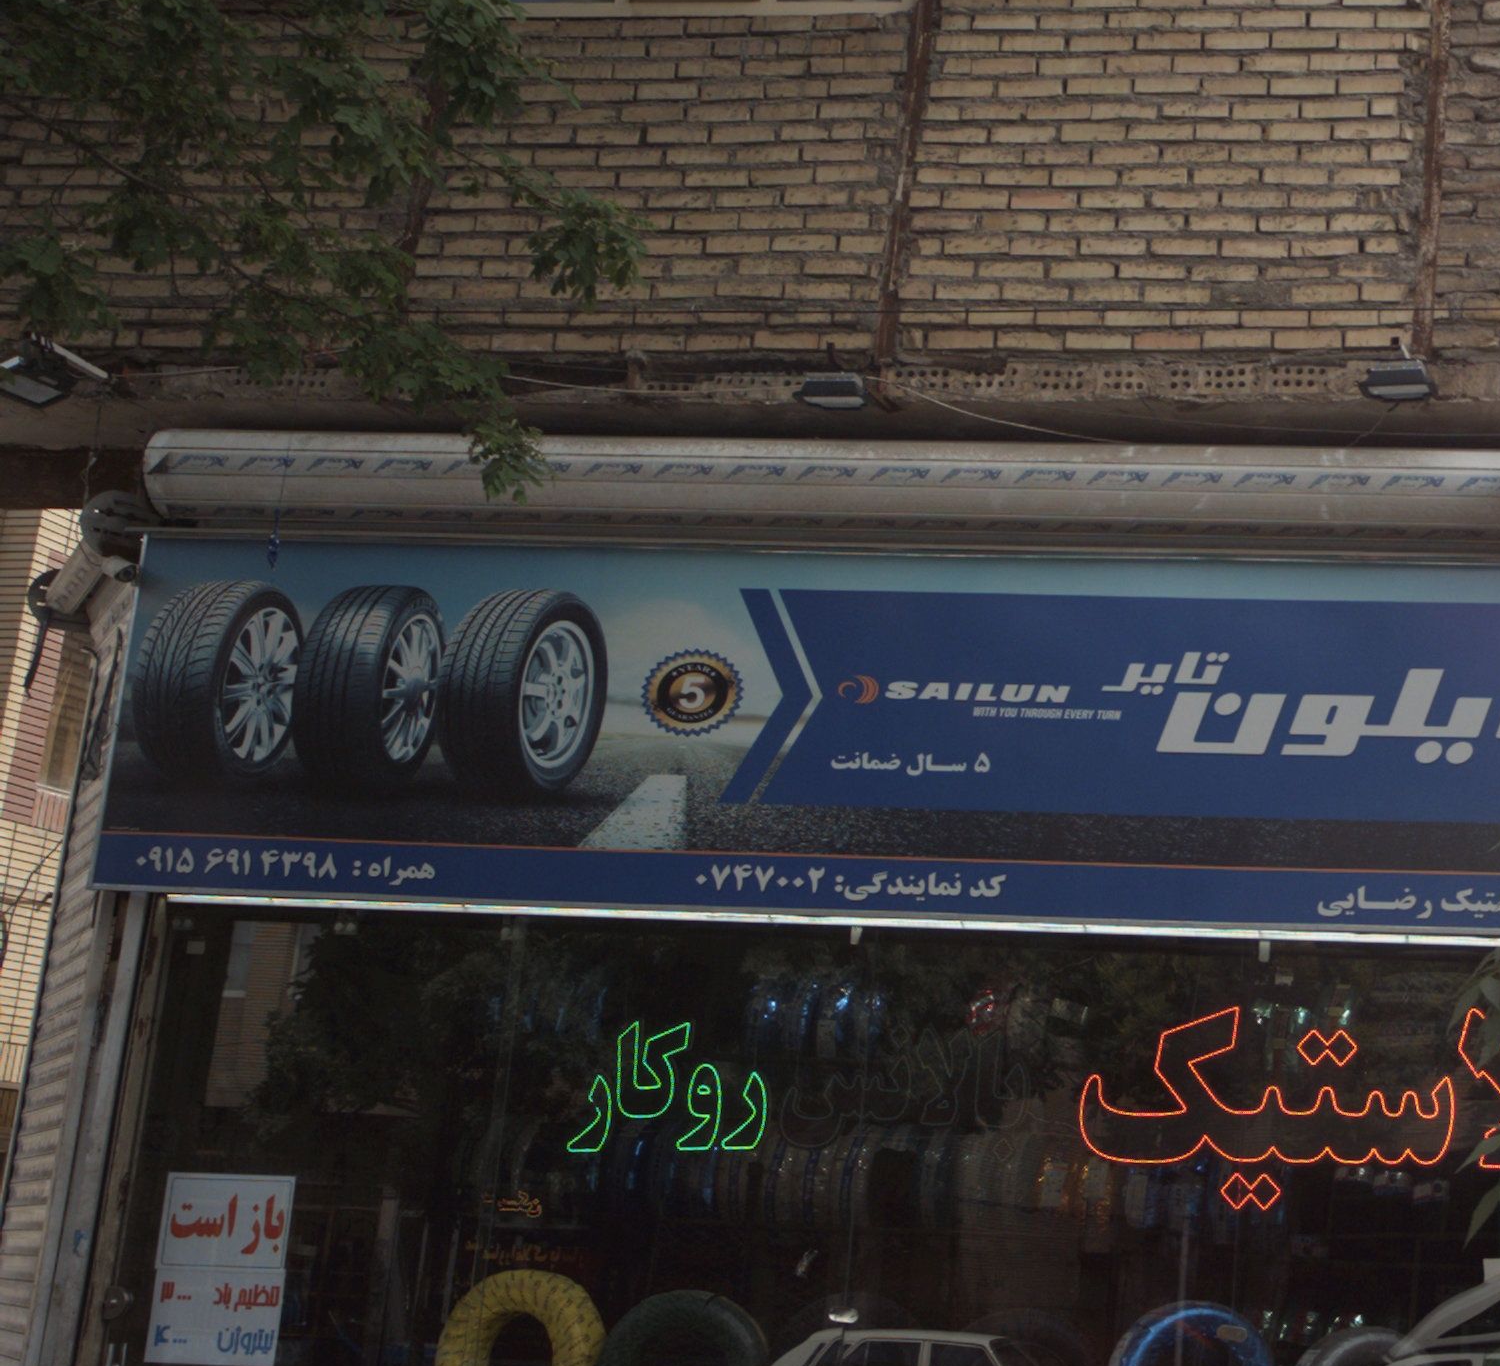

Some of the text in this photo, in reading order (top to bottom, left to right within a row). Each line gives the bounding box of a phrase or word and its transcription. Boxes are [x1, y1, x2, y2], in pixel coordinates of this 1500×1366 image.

[678, 664, 712, 674] YEAR
[1101, 651, 1230, 695] تایر
[679, 675, 706, 709] 5
[884, 681, 1071, 703] SAILUN
[973, 706, 1122, 721] WITH YOU THROUGH EVERY TURN
[830, 751, 991, 776] ۵ سال ضمانت
[695, 863, 826, 894] ۰۷۴۷۰۰۲
[969, 874, 1007, 898] کد
[1316, 885, 1433, 920] رضایی
[567, 1020, 768, 1153] روکار
[170, 1193, 285, 1255] باز است
[213, 1283, 233, 1310] باد
[235, 1285, 281, 1312] تنظیم
[216, 1326, 276, 1356] نیتروژن
